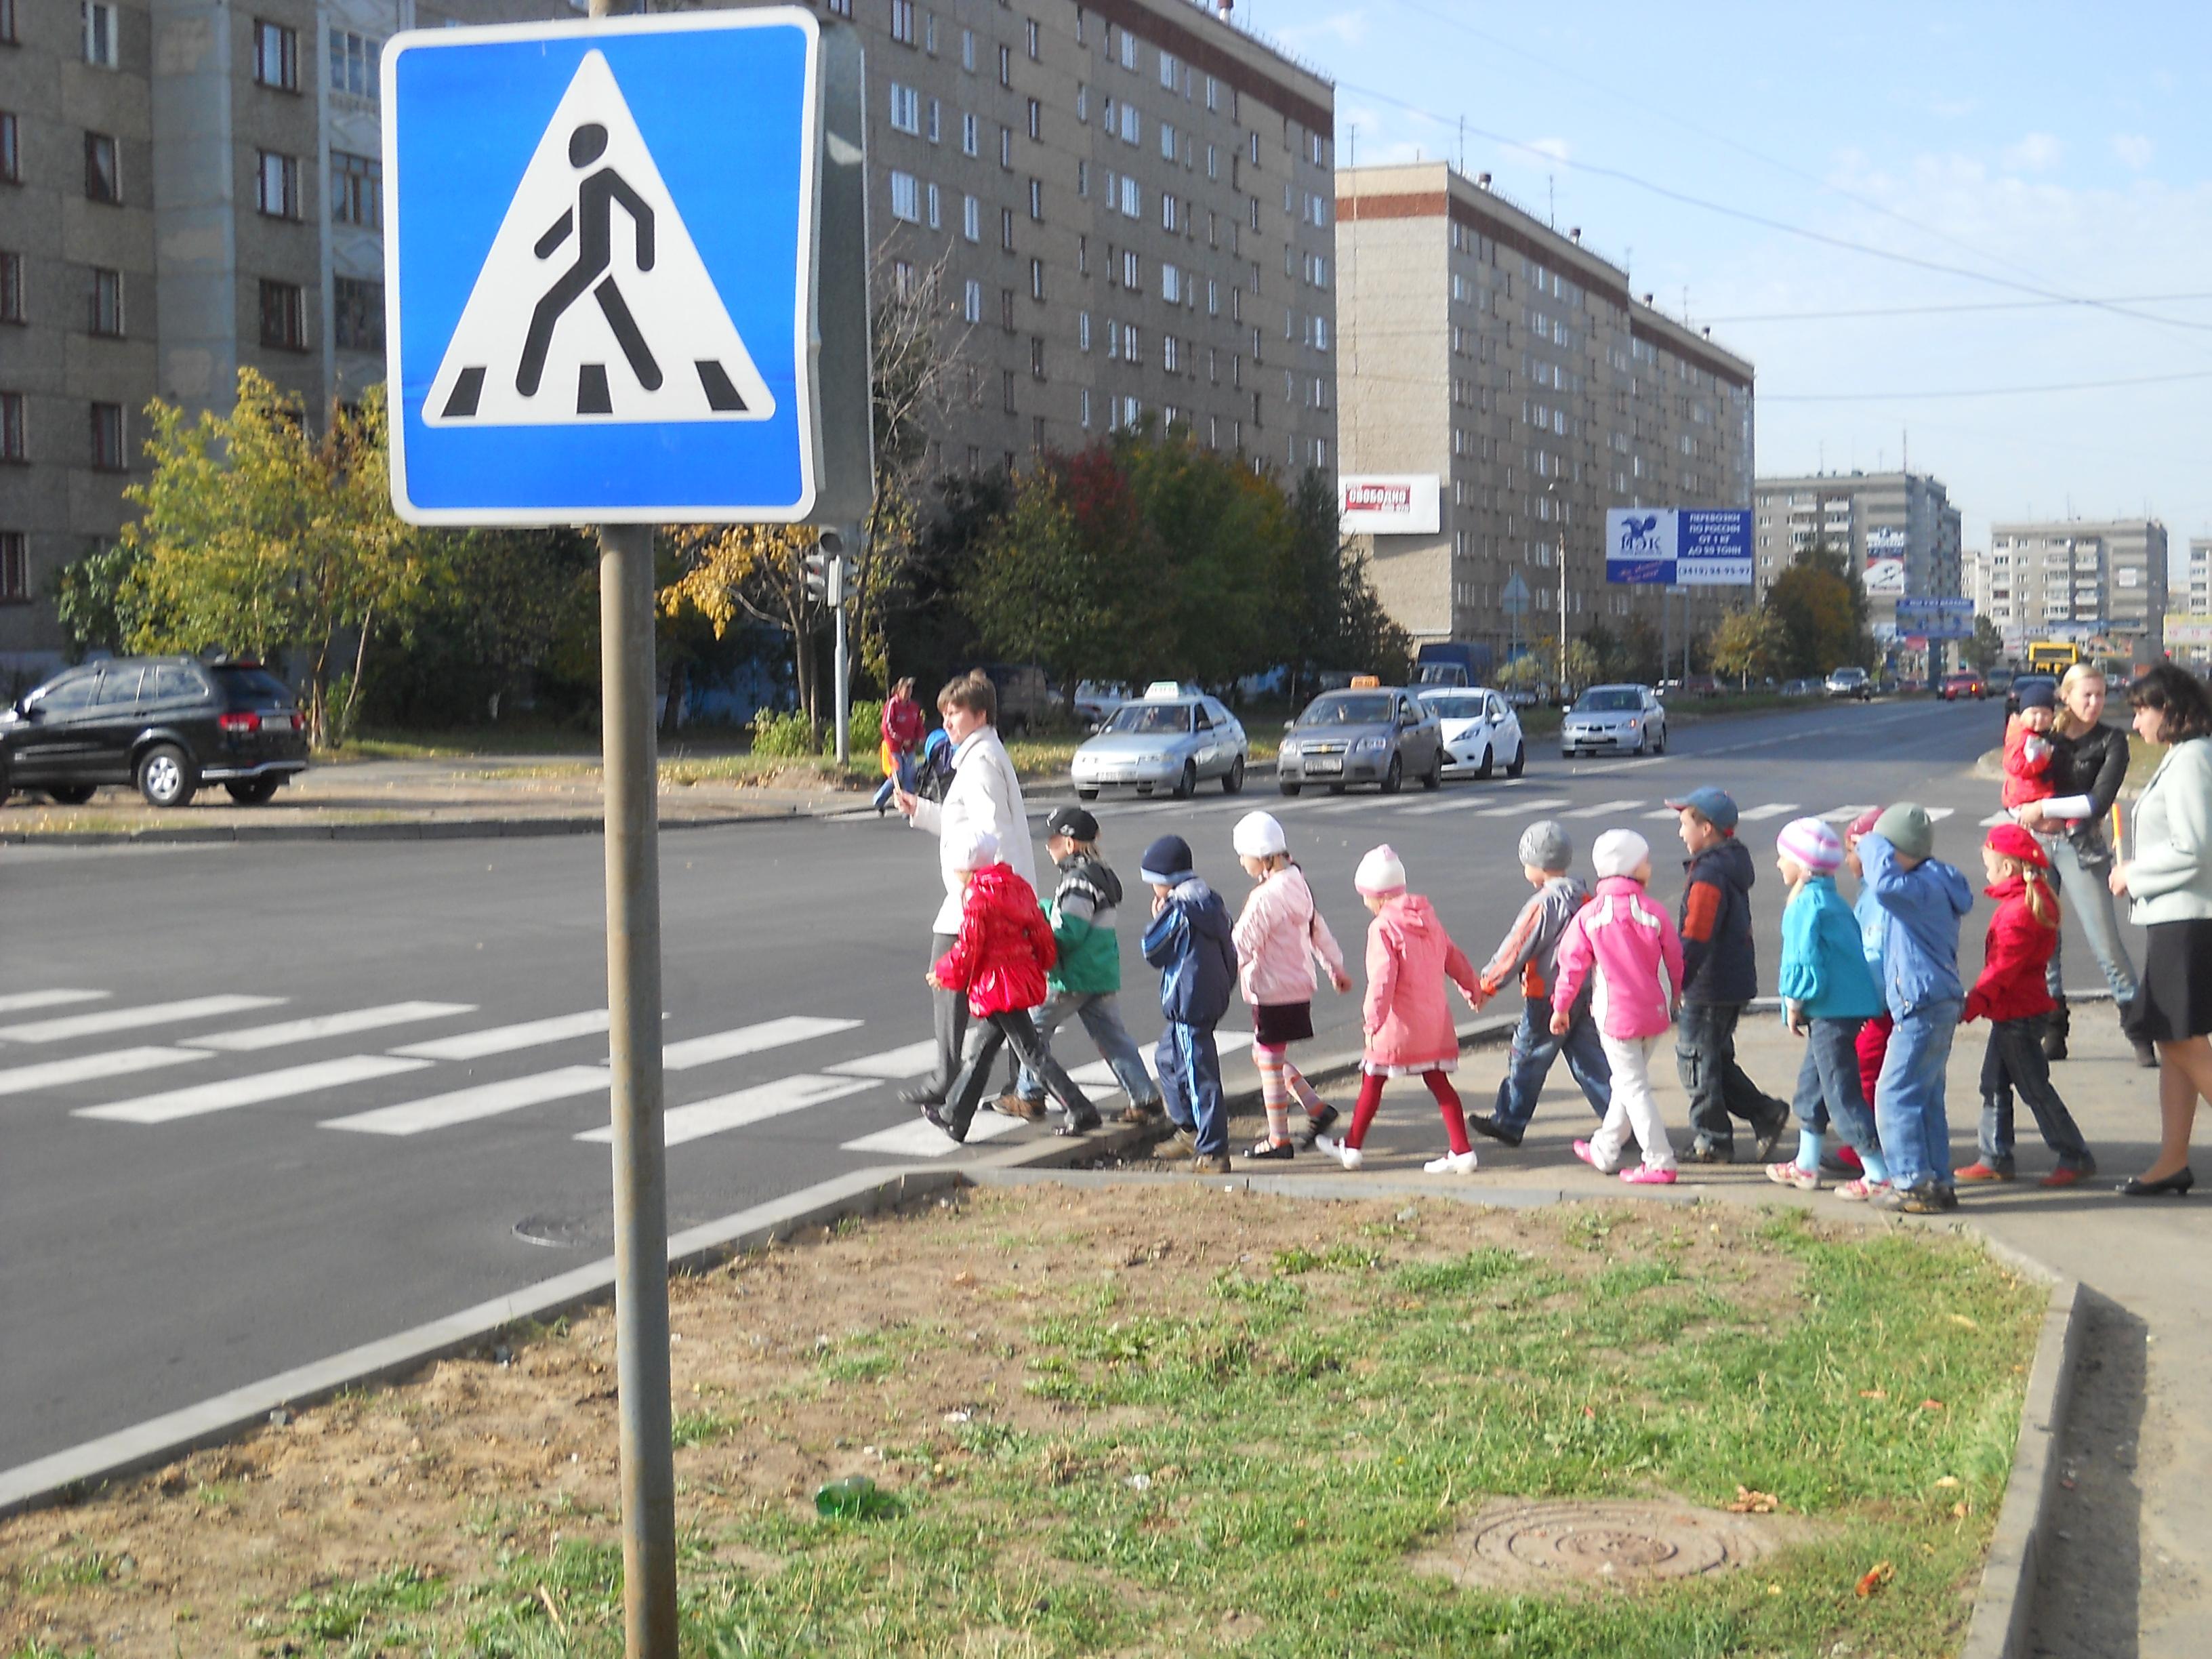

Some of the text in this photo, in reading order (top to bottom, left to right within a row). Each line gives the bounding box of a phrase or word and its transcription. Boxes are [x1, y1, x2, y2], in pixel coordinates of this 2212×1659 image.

[1689, 513, 1740, 523] ПЕРЕВОЗКИ
[1689, 524, 1740, 534] ПО РОССИИ
[1698, 535, 1711, 544] ОТ
[1720, 535, 1730, 544] КГ
[1687, 545, 1702, 556] ДО
[1717, 545, 1742, 555] ТОНН
